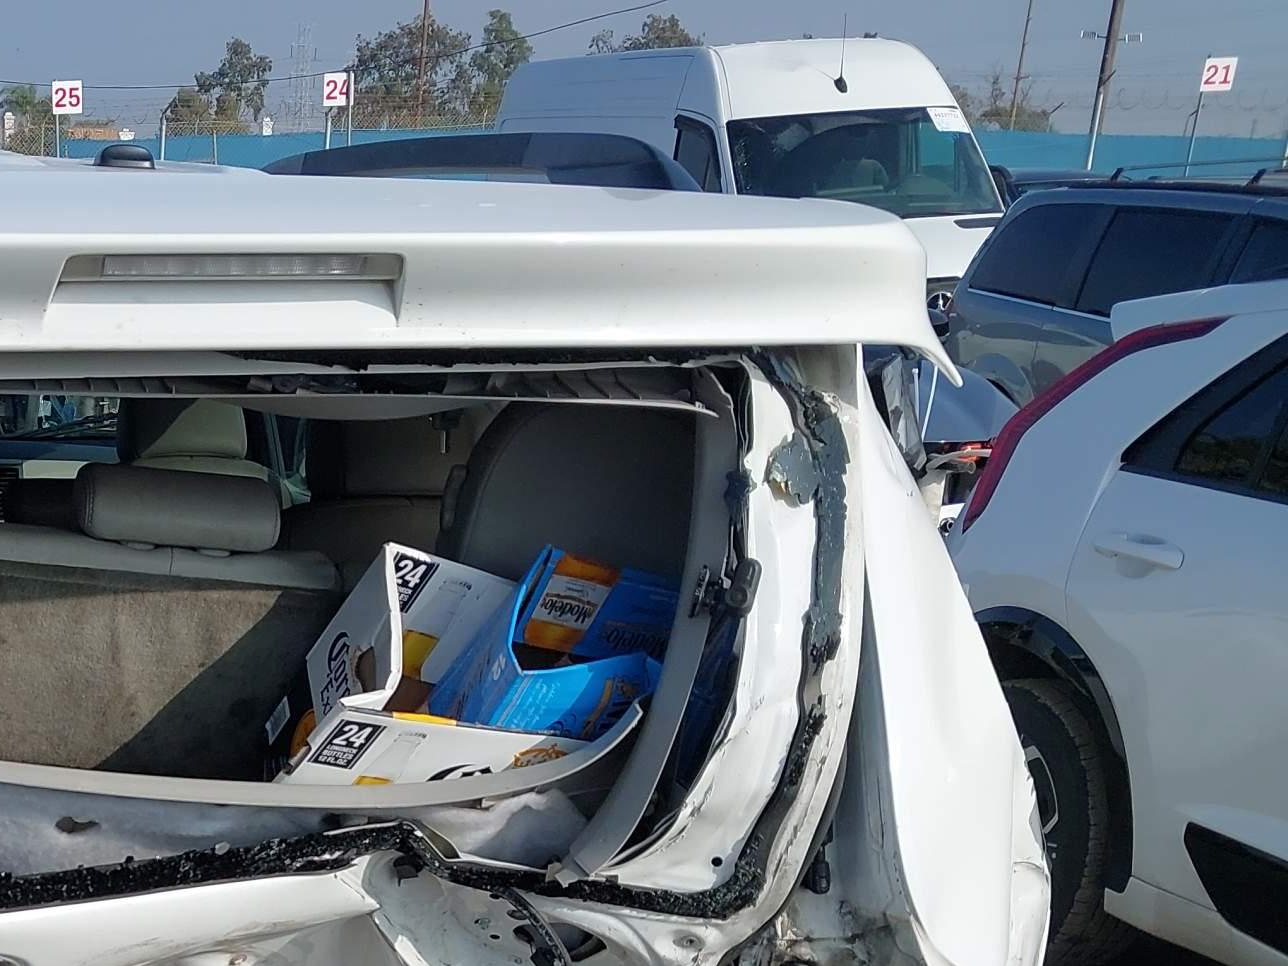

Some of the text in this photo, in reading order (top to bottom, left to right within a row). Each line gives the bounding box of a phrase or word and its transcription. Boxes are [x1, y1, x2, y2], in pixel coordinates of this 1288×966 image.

[1203, 64, 1231, 85] 21
[55, 87, 80, 107] 25
[326, 79, 349, 100] 24
[396, 559, 428, 588] 24
[544, 599, 589, 624] Modelo
[332, 724, 374, 747] 24
